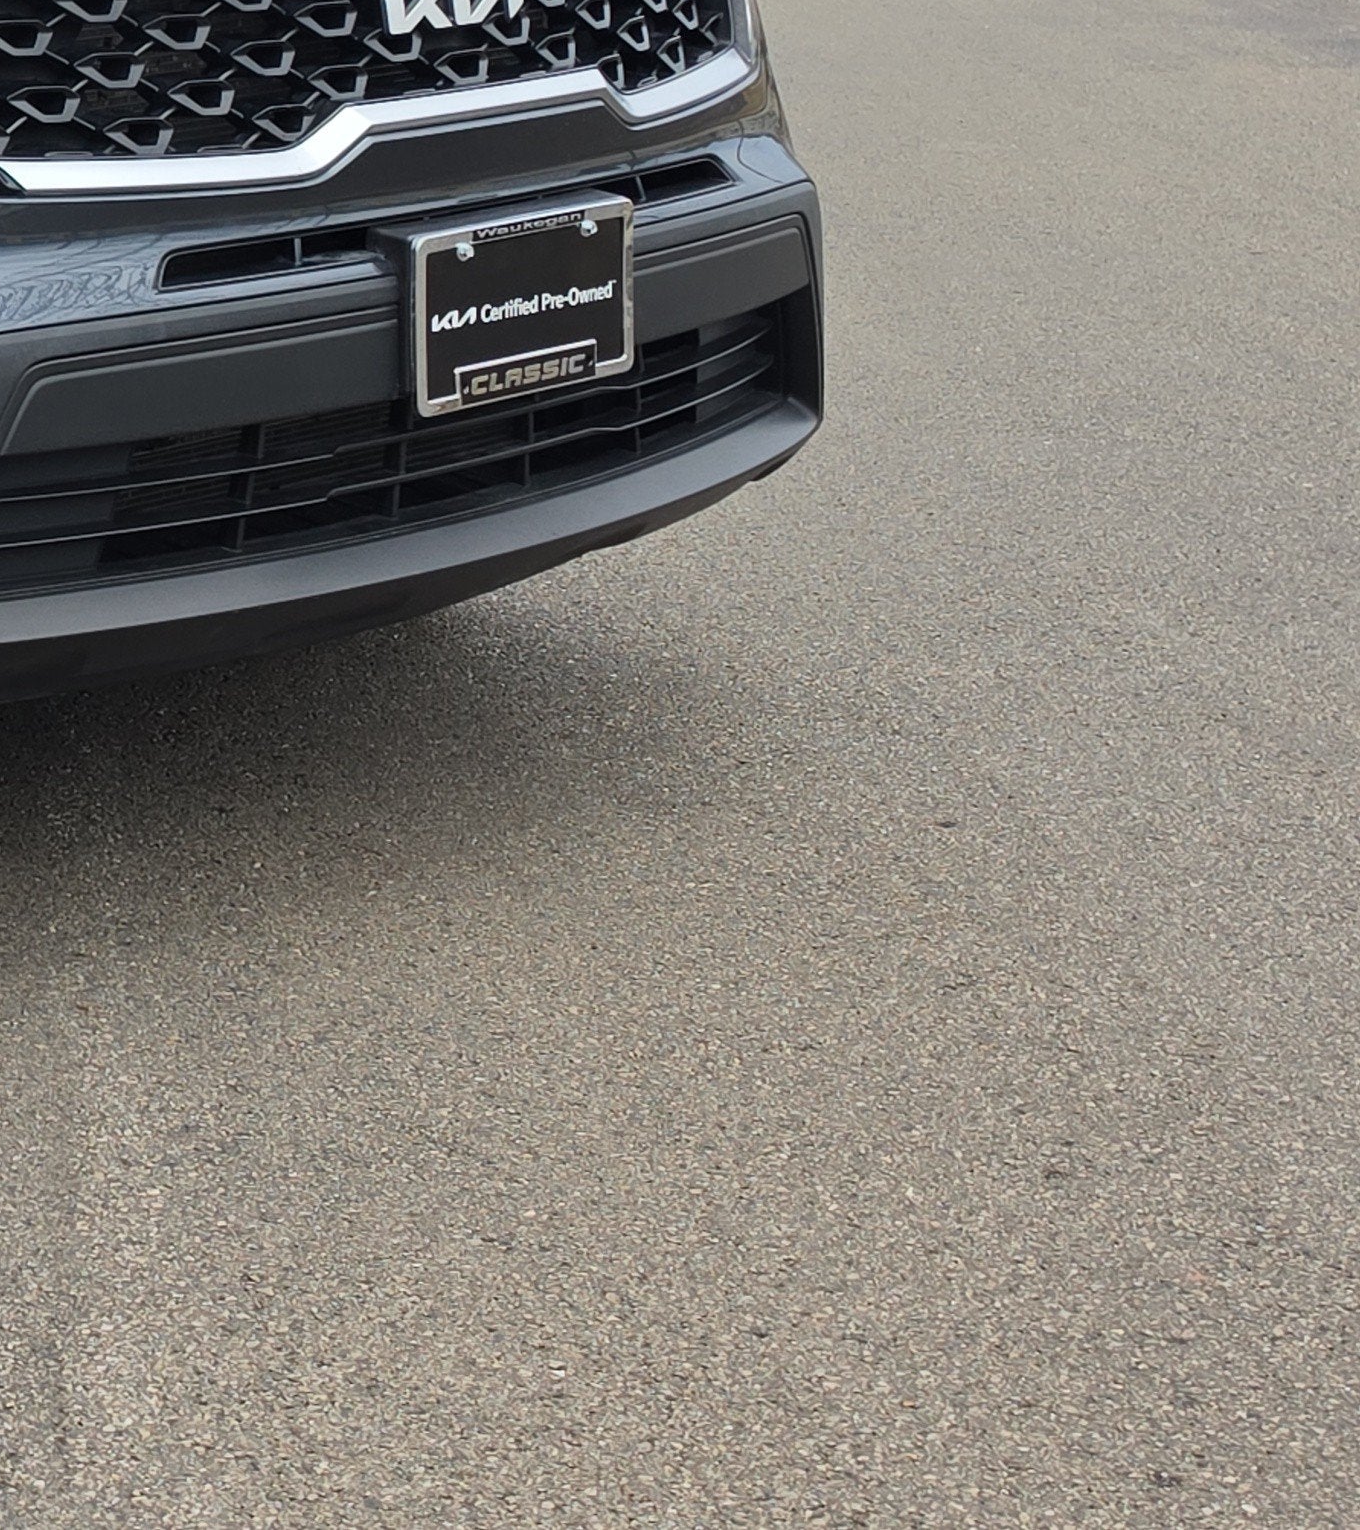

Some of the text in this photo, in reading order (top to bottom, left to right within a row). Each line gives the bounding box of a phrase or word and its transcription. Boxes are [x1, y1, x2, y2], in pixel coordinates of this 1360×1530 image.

[477, 213, 582, 239] Waukegan
[431, 281, 614, 332] KIA Certified Pre-Owned
[471, 353, 586, 396] CLASSIC
